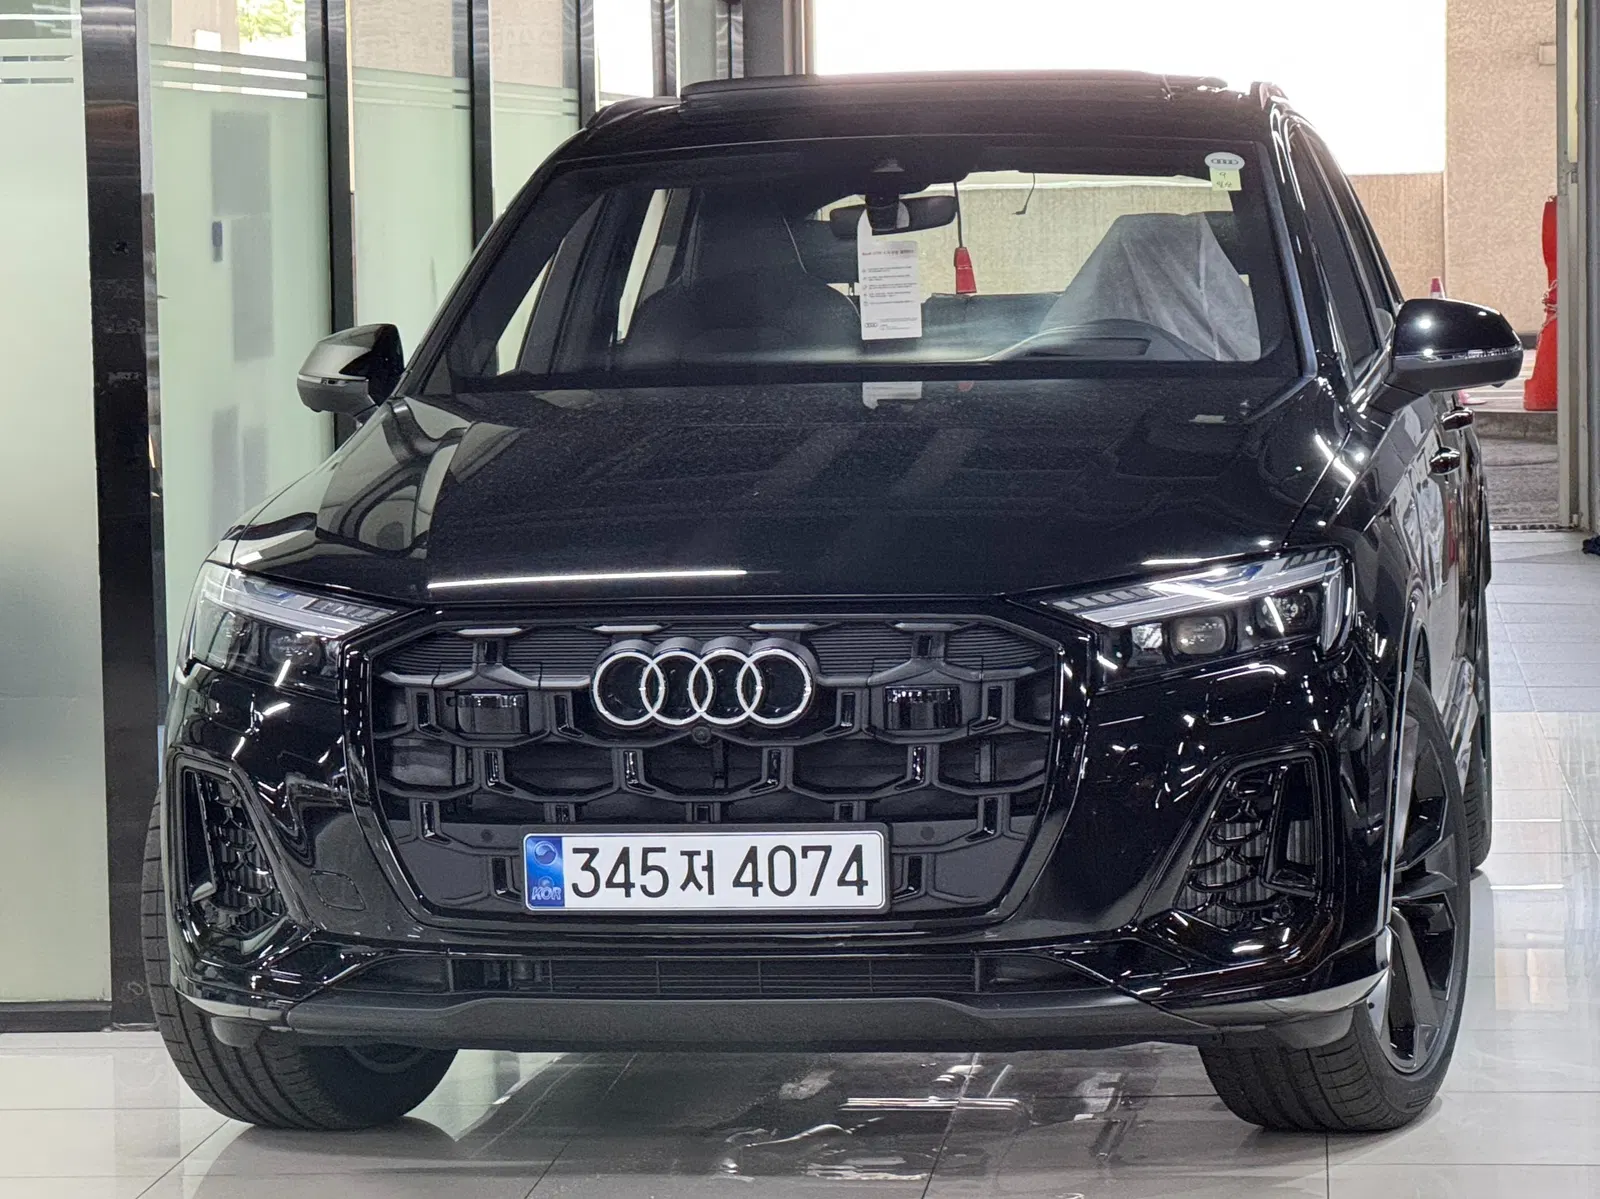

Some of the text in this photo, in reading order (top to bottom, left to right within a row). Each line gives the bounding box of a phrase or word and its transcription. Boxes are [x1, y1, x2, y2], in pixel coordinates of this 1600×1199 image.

[571, 844, 869, 898] 345저 4074
[531, 886, 562, 900] KOR
